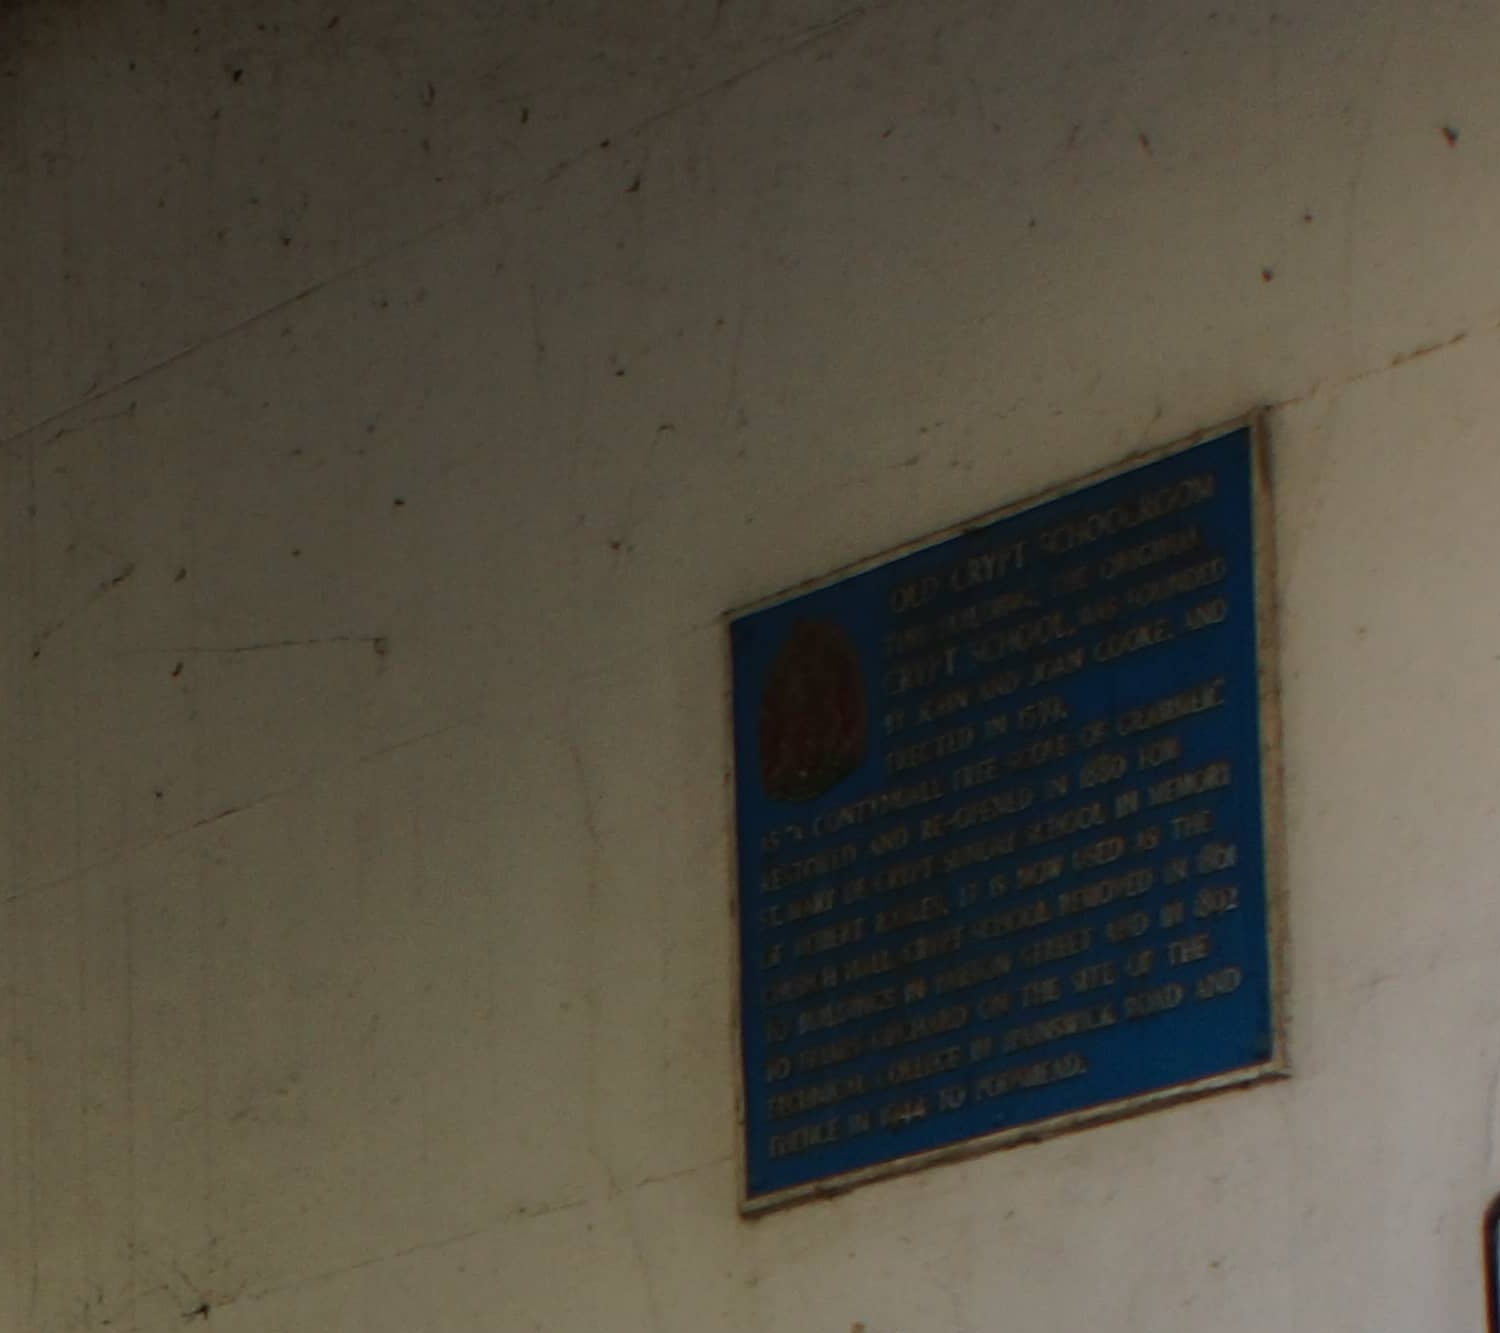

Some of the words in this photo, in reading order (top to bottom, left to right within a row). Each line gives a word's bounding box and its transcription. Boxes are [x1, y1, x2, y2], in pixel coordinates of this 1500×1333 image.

[1185, 597, 1228, 633] AND
[1114, 790, 1139, 820] IN
[1021, 977, 1061, 1009] THE
[1168, 935, 1208, 968] THE
[1195, 967, 1242, 1001] AND
